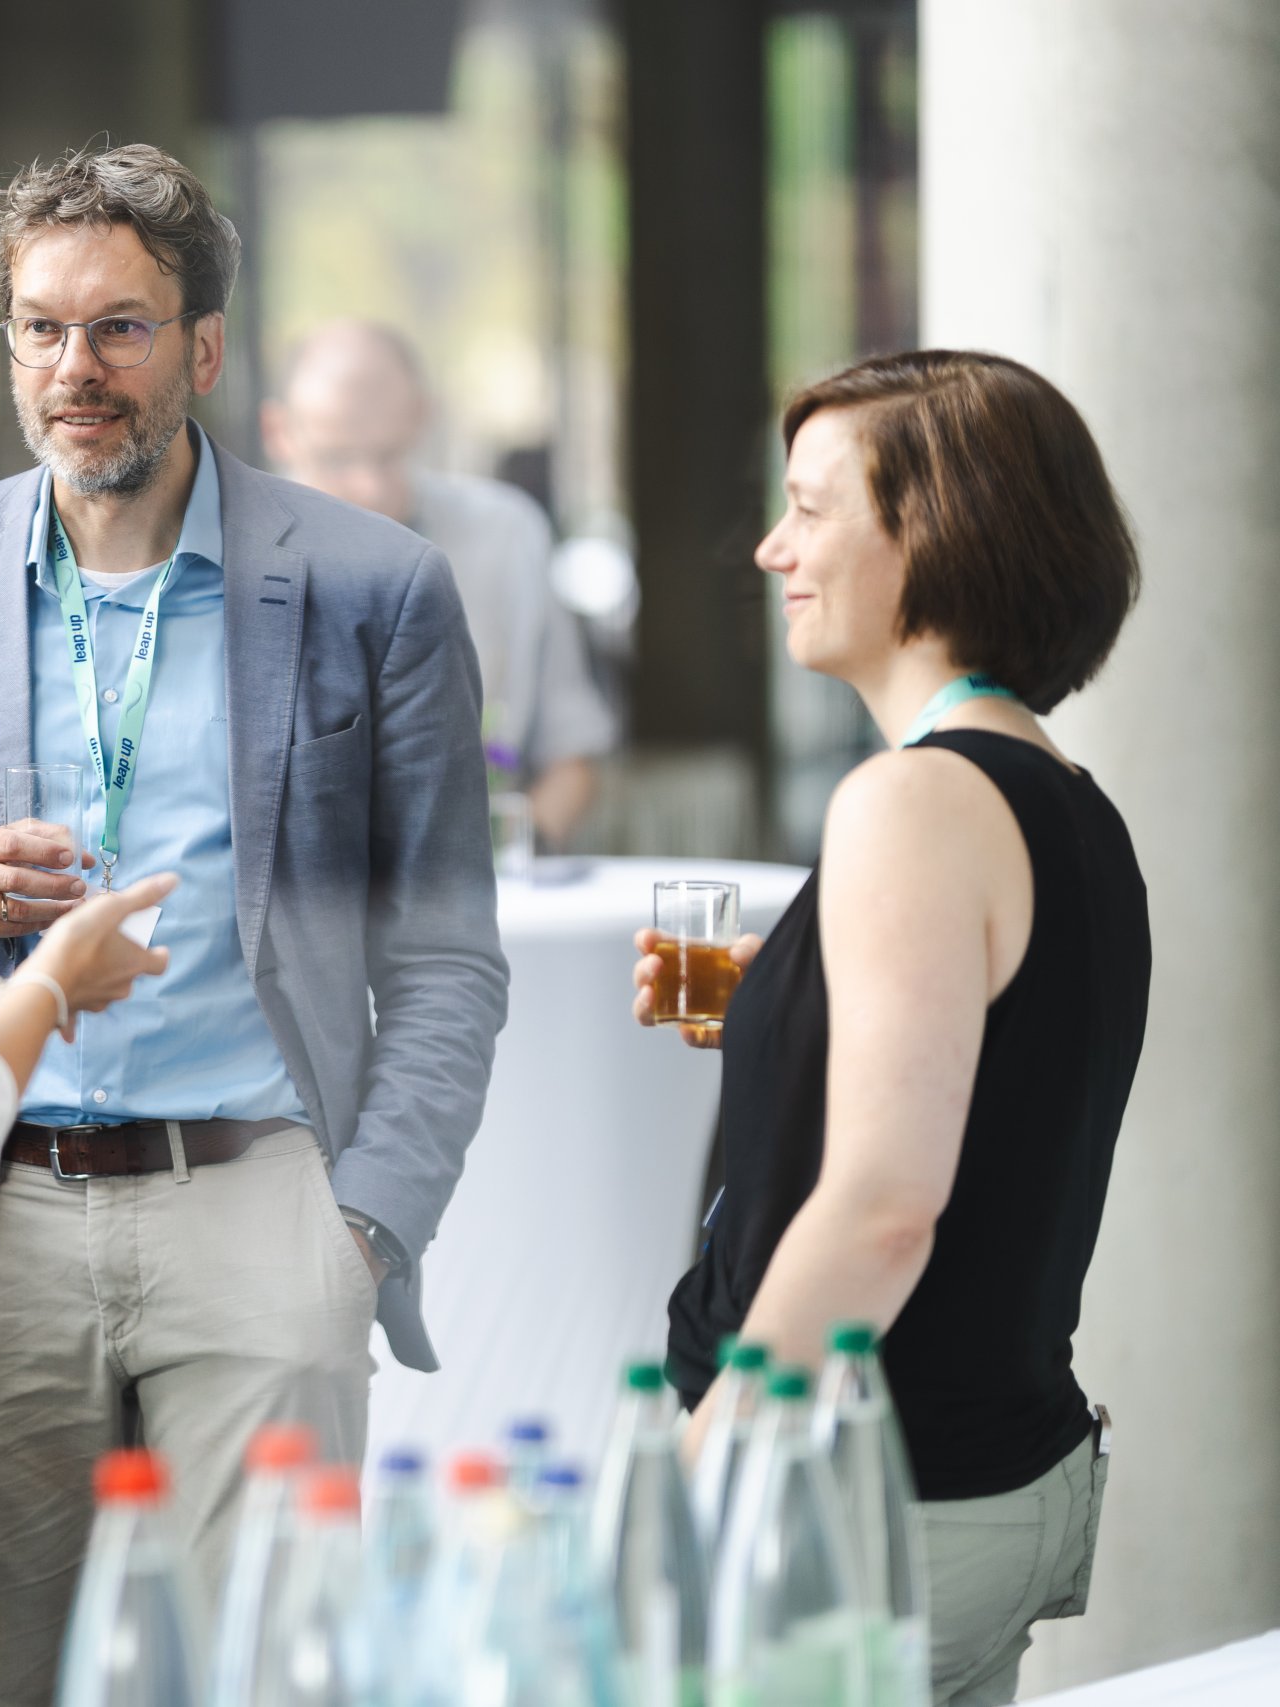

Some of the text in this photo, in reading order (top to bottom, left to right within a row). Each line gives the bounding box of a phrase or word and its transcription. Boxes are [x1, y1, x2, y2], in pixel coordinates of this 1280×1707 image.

[70, 614, 87, 663] leap up
[135, 611, 155, 660] leap up
[113, 738, 134, 789] leap up
